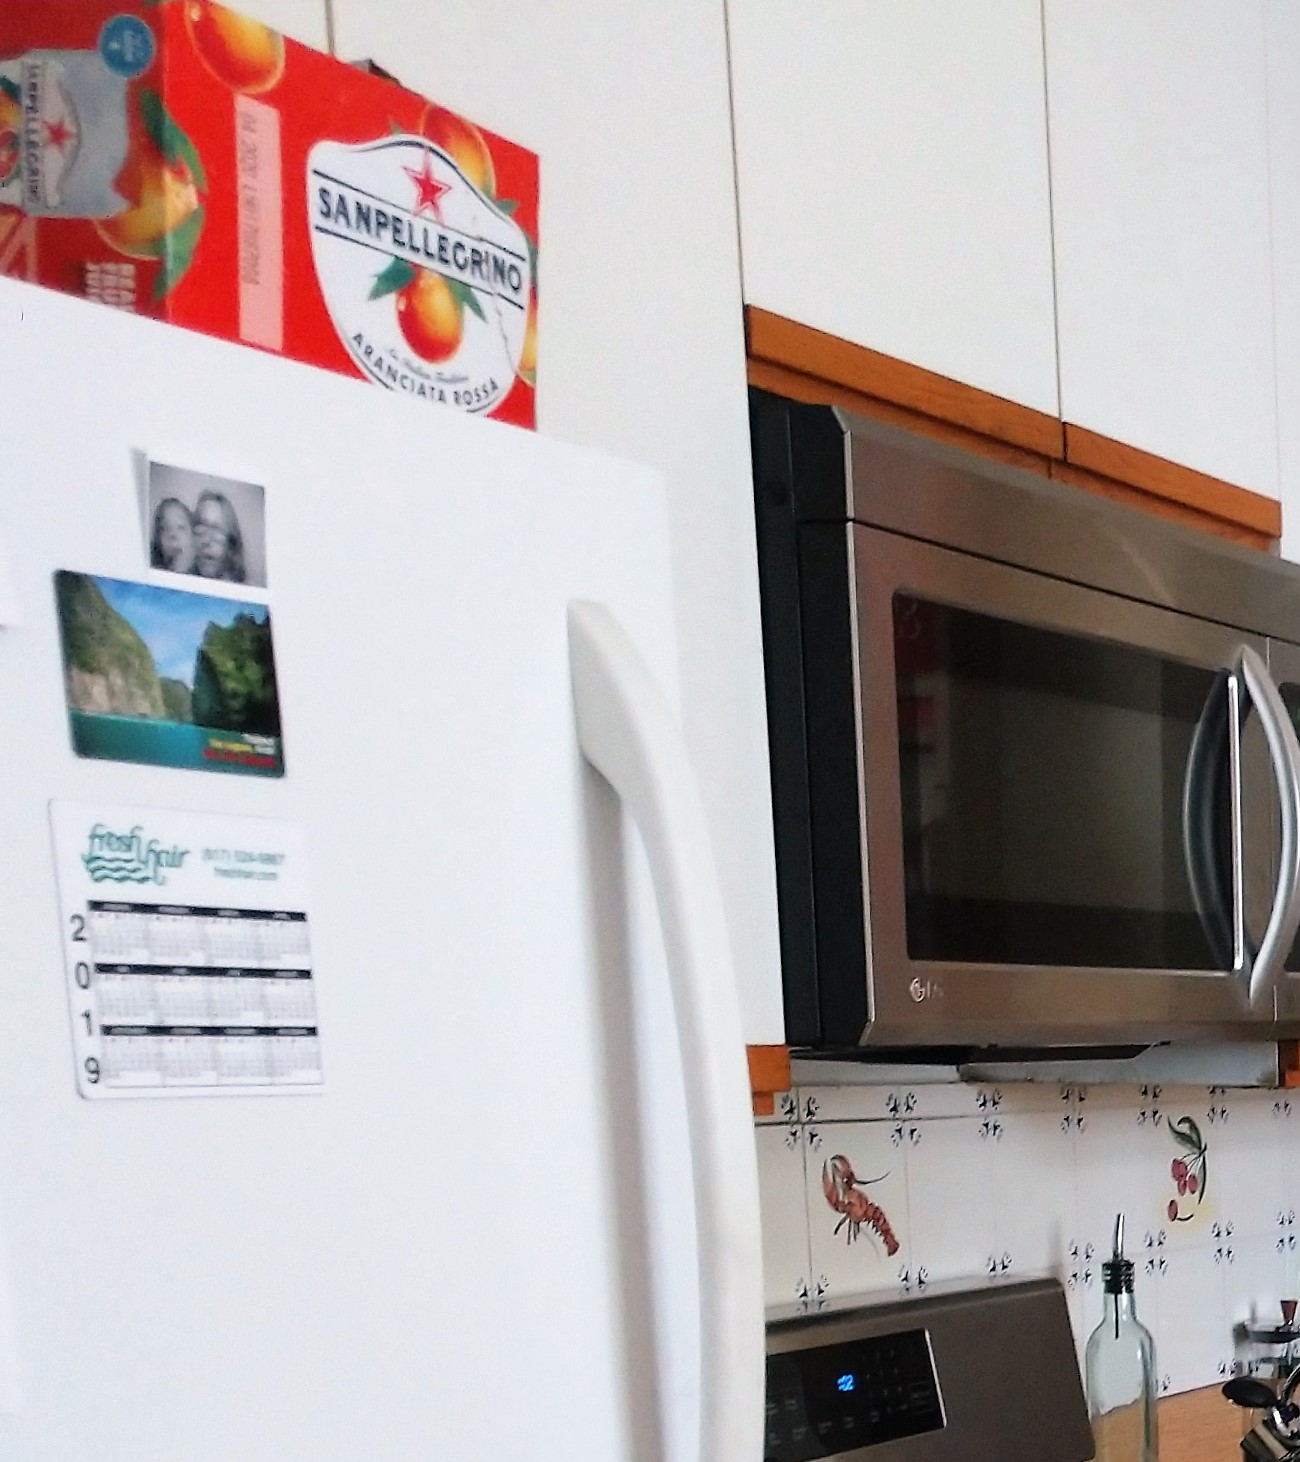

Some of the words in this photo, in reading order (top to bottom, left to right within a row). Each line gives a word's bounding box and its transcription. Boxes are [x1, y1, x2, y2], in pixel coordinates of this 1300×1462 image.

[318, 186, 523, 295] SANPELLEGRINO
[351, 332, 448, 404] ARANCIATA
[453, 376, 500, 406] ROSSA
